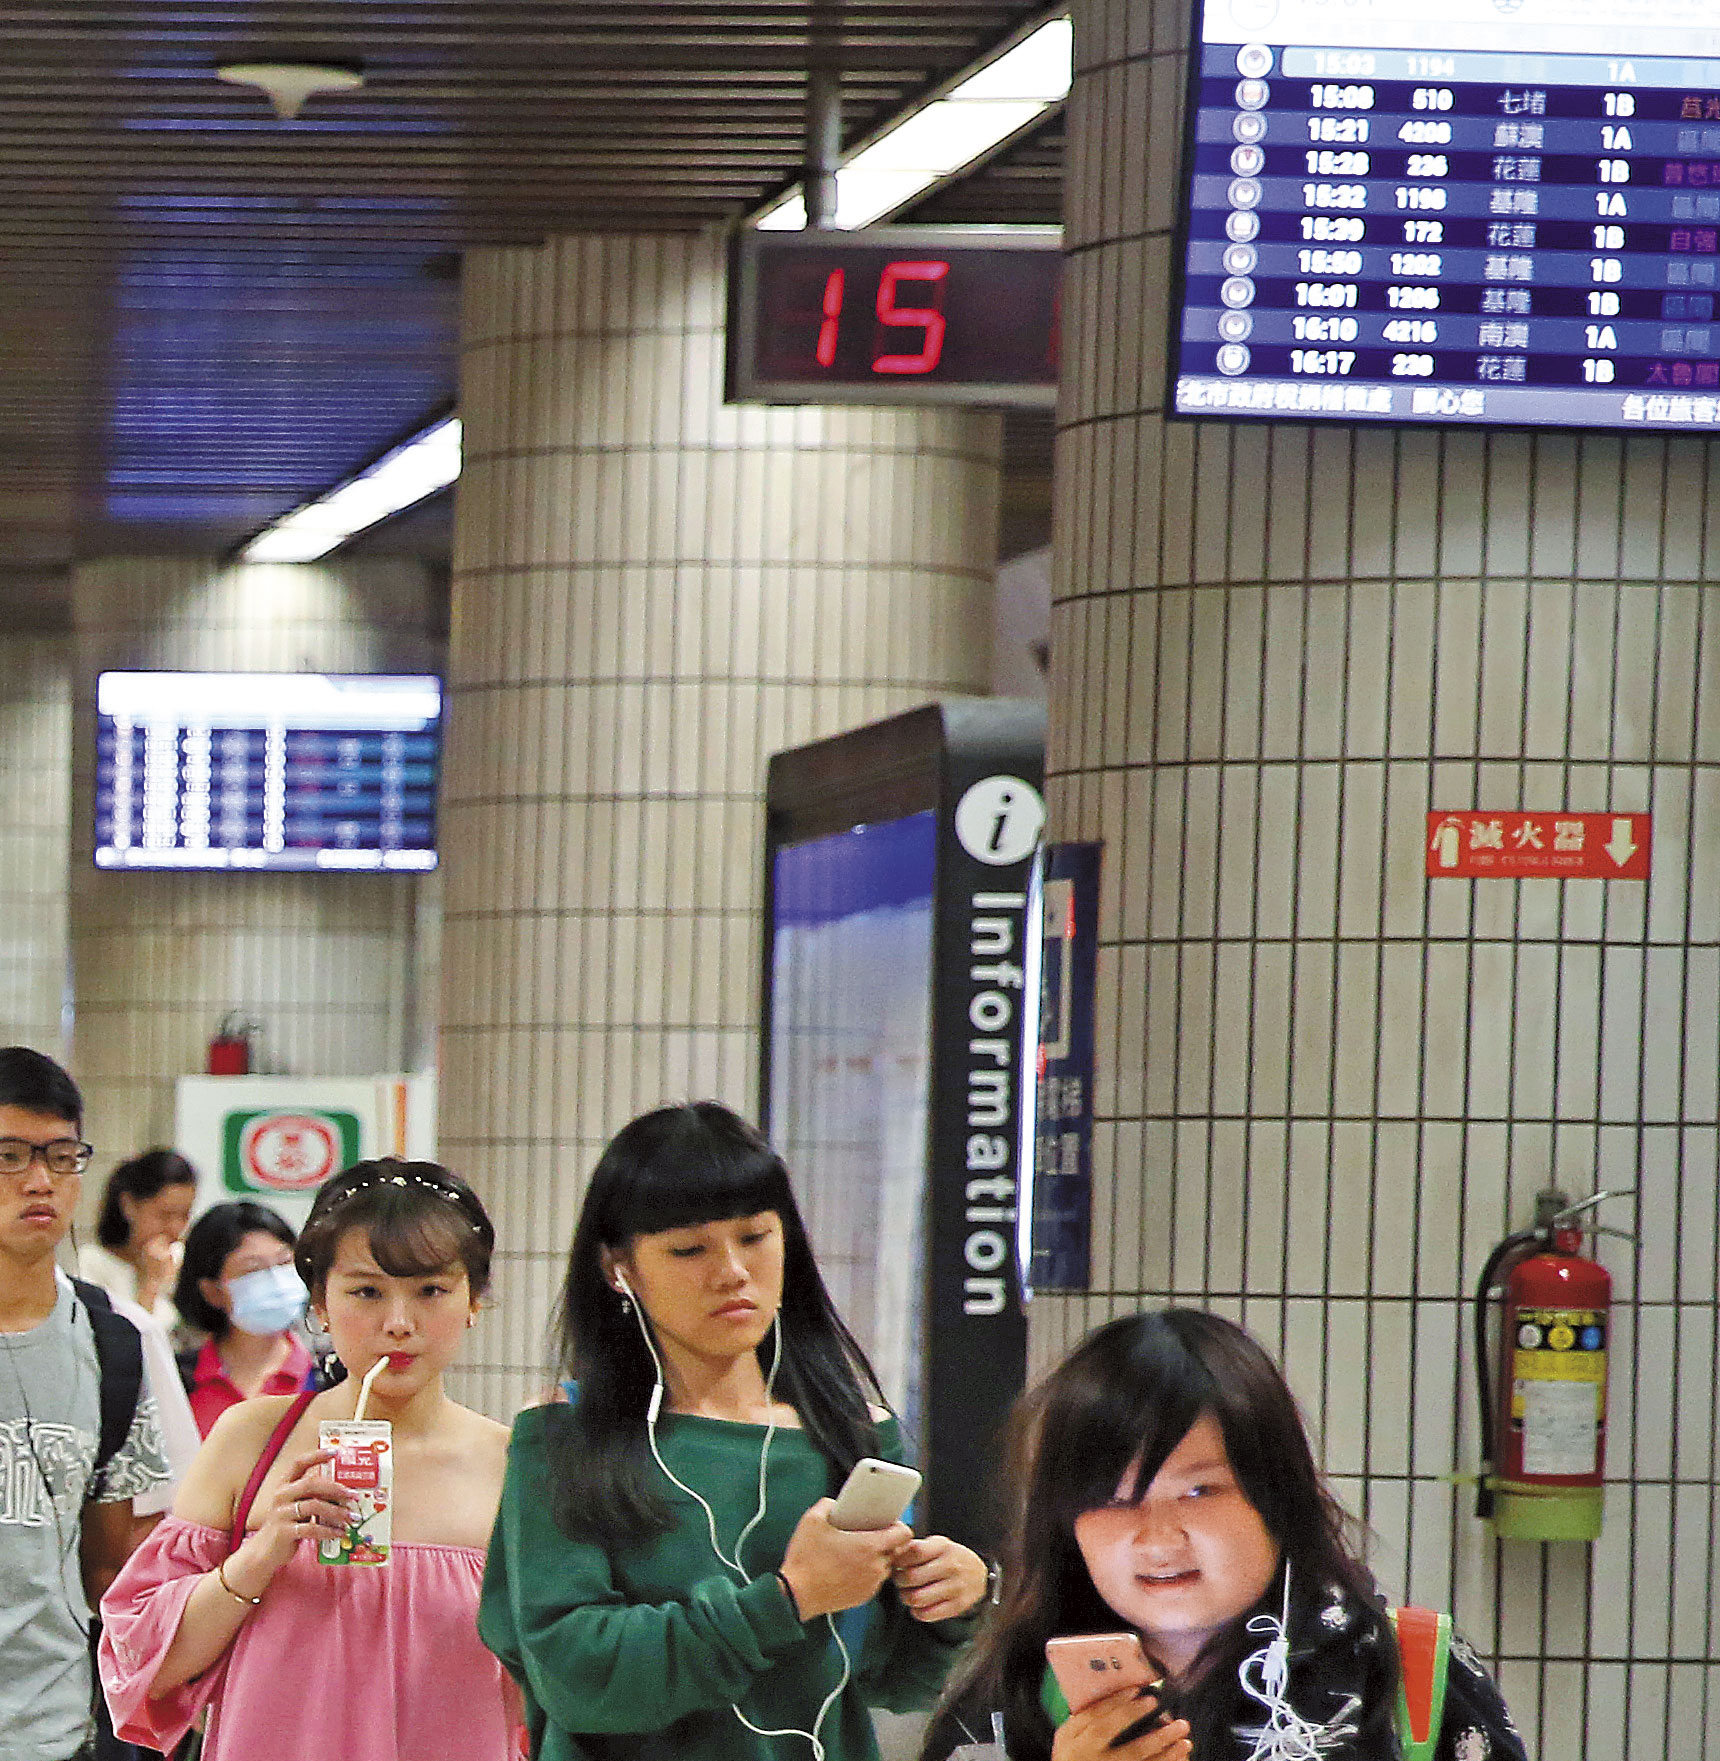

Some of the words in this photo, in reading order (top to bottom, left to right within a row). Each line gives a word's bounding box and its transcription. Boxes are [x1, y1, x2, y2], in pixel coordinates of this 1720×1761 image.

[1608, 61, 1637, 82] 1A
[1413, 88, 1454, 111] 510
[1603, 92, 1635, 117] 1B
[1601, 126, 1633, 150] 1A
[1598, 159, 1631, 183] 1B
[1595, 192, 1628, 216] 1A
[1404, 221, 1444, 242] 172
[1593, 225, 1625, 249] 1B
[1590, 258, 1623, 282] 1B
[1587, 291, 1621, 315] 1B
[816, 260, 950, 375] 15
[1585, 325, 1617, 349] 1A
[1583, 358, 1615, 383] 1B
[963, 891, 1026, 1315] Information
